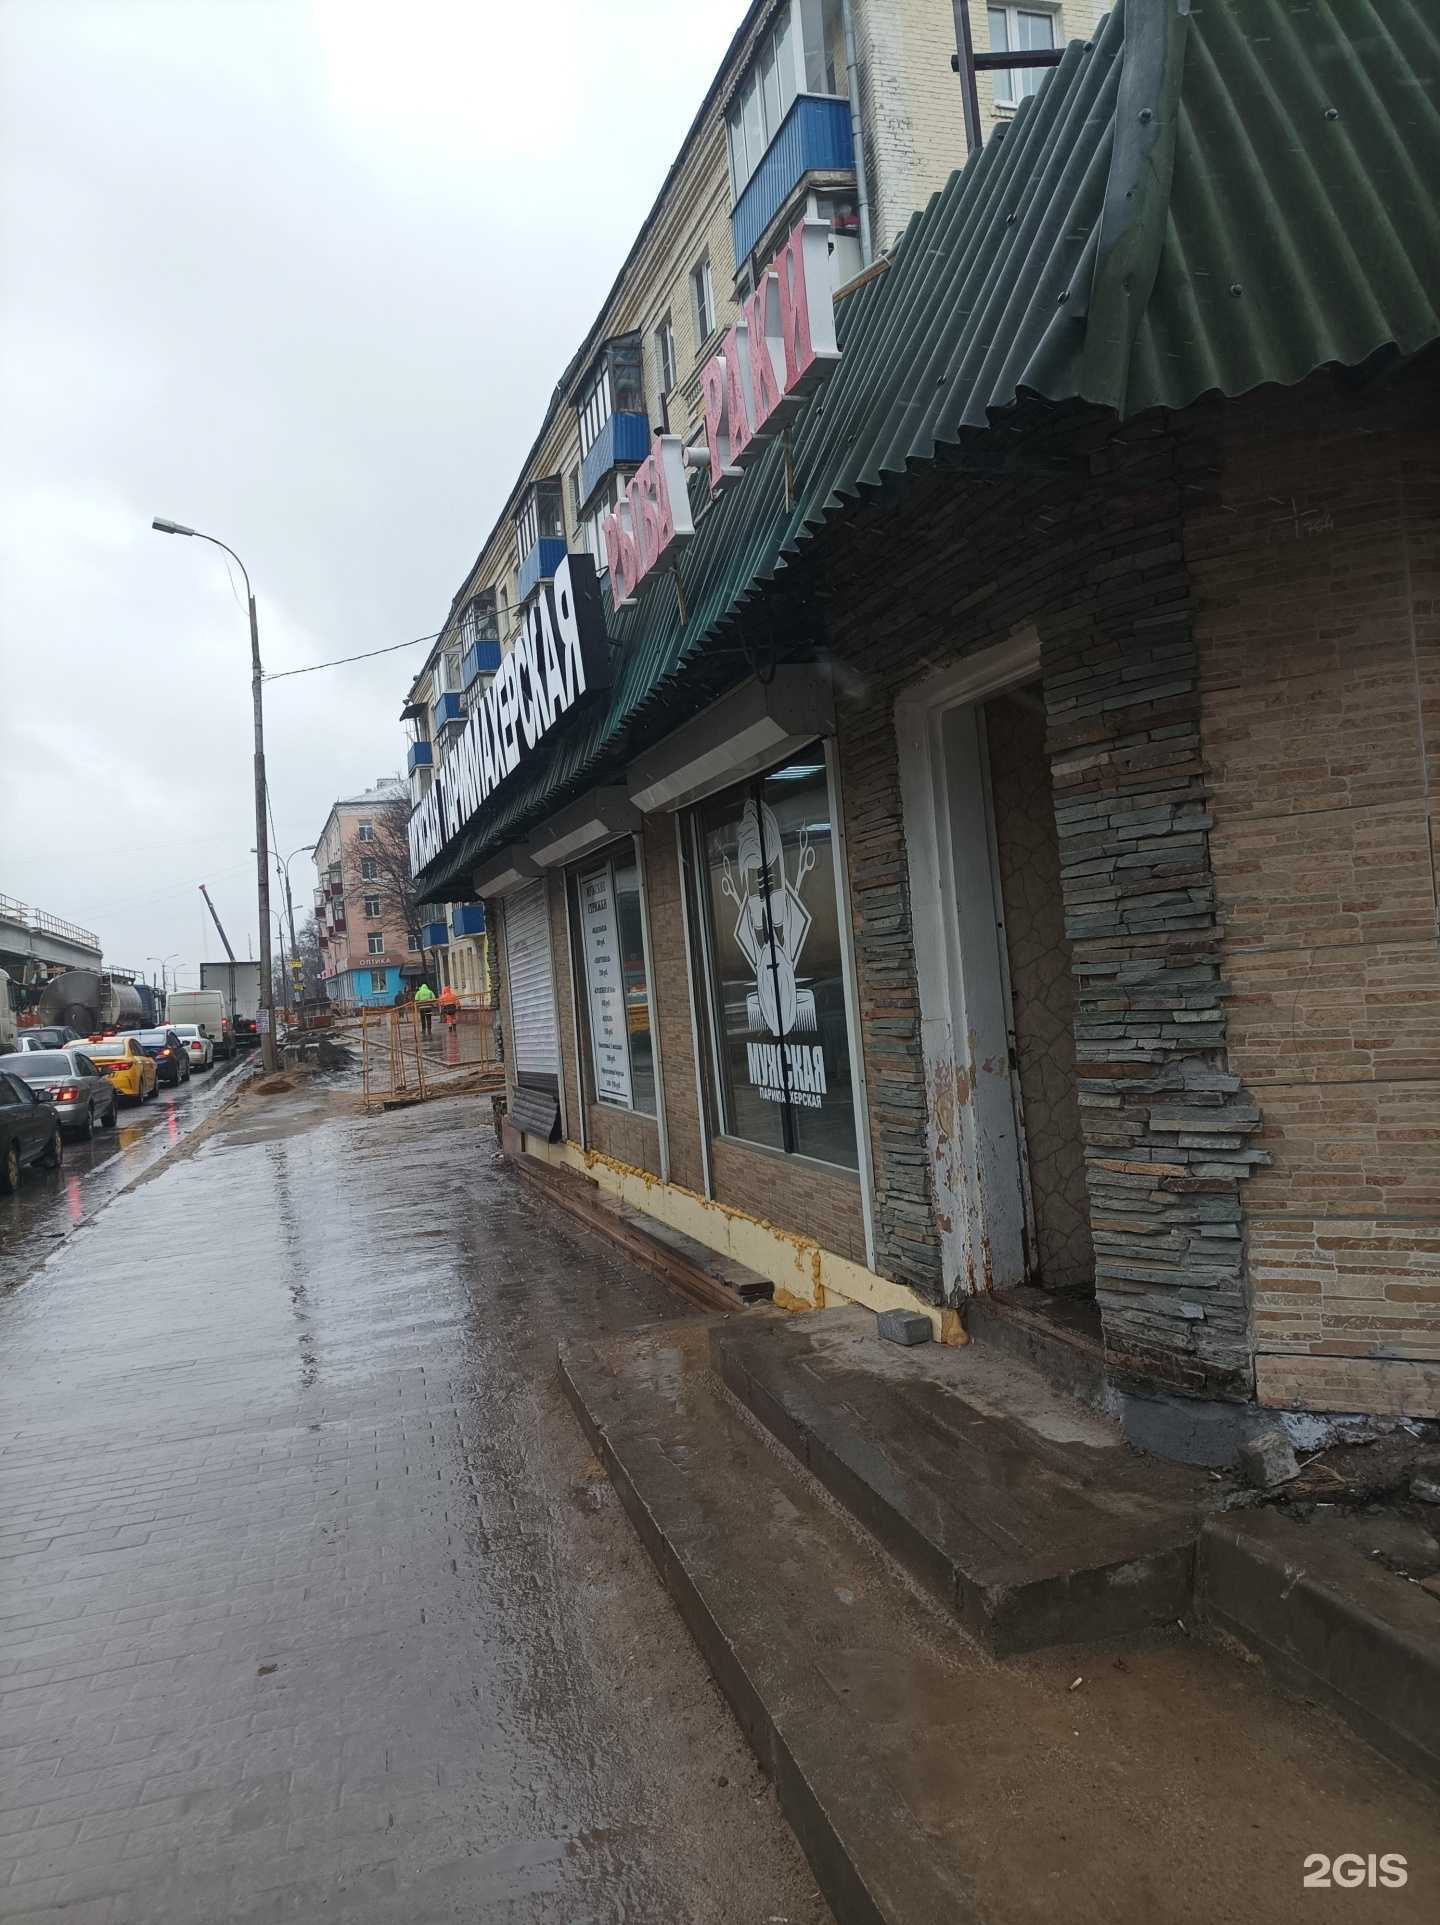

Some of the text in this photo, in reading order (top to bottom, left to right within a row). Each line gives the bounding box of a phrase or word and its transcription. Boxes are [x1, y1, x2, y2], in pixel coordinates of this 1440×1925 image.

[701, 220, 818, 490] РАКИ
[440, 553, 587, 844] ПАРИКМАХЕРСКАЯ
[359, 957, 392, 967] ОПТИКА
[746, 1042, 827, 1095] МУЖСКАЯ
